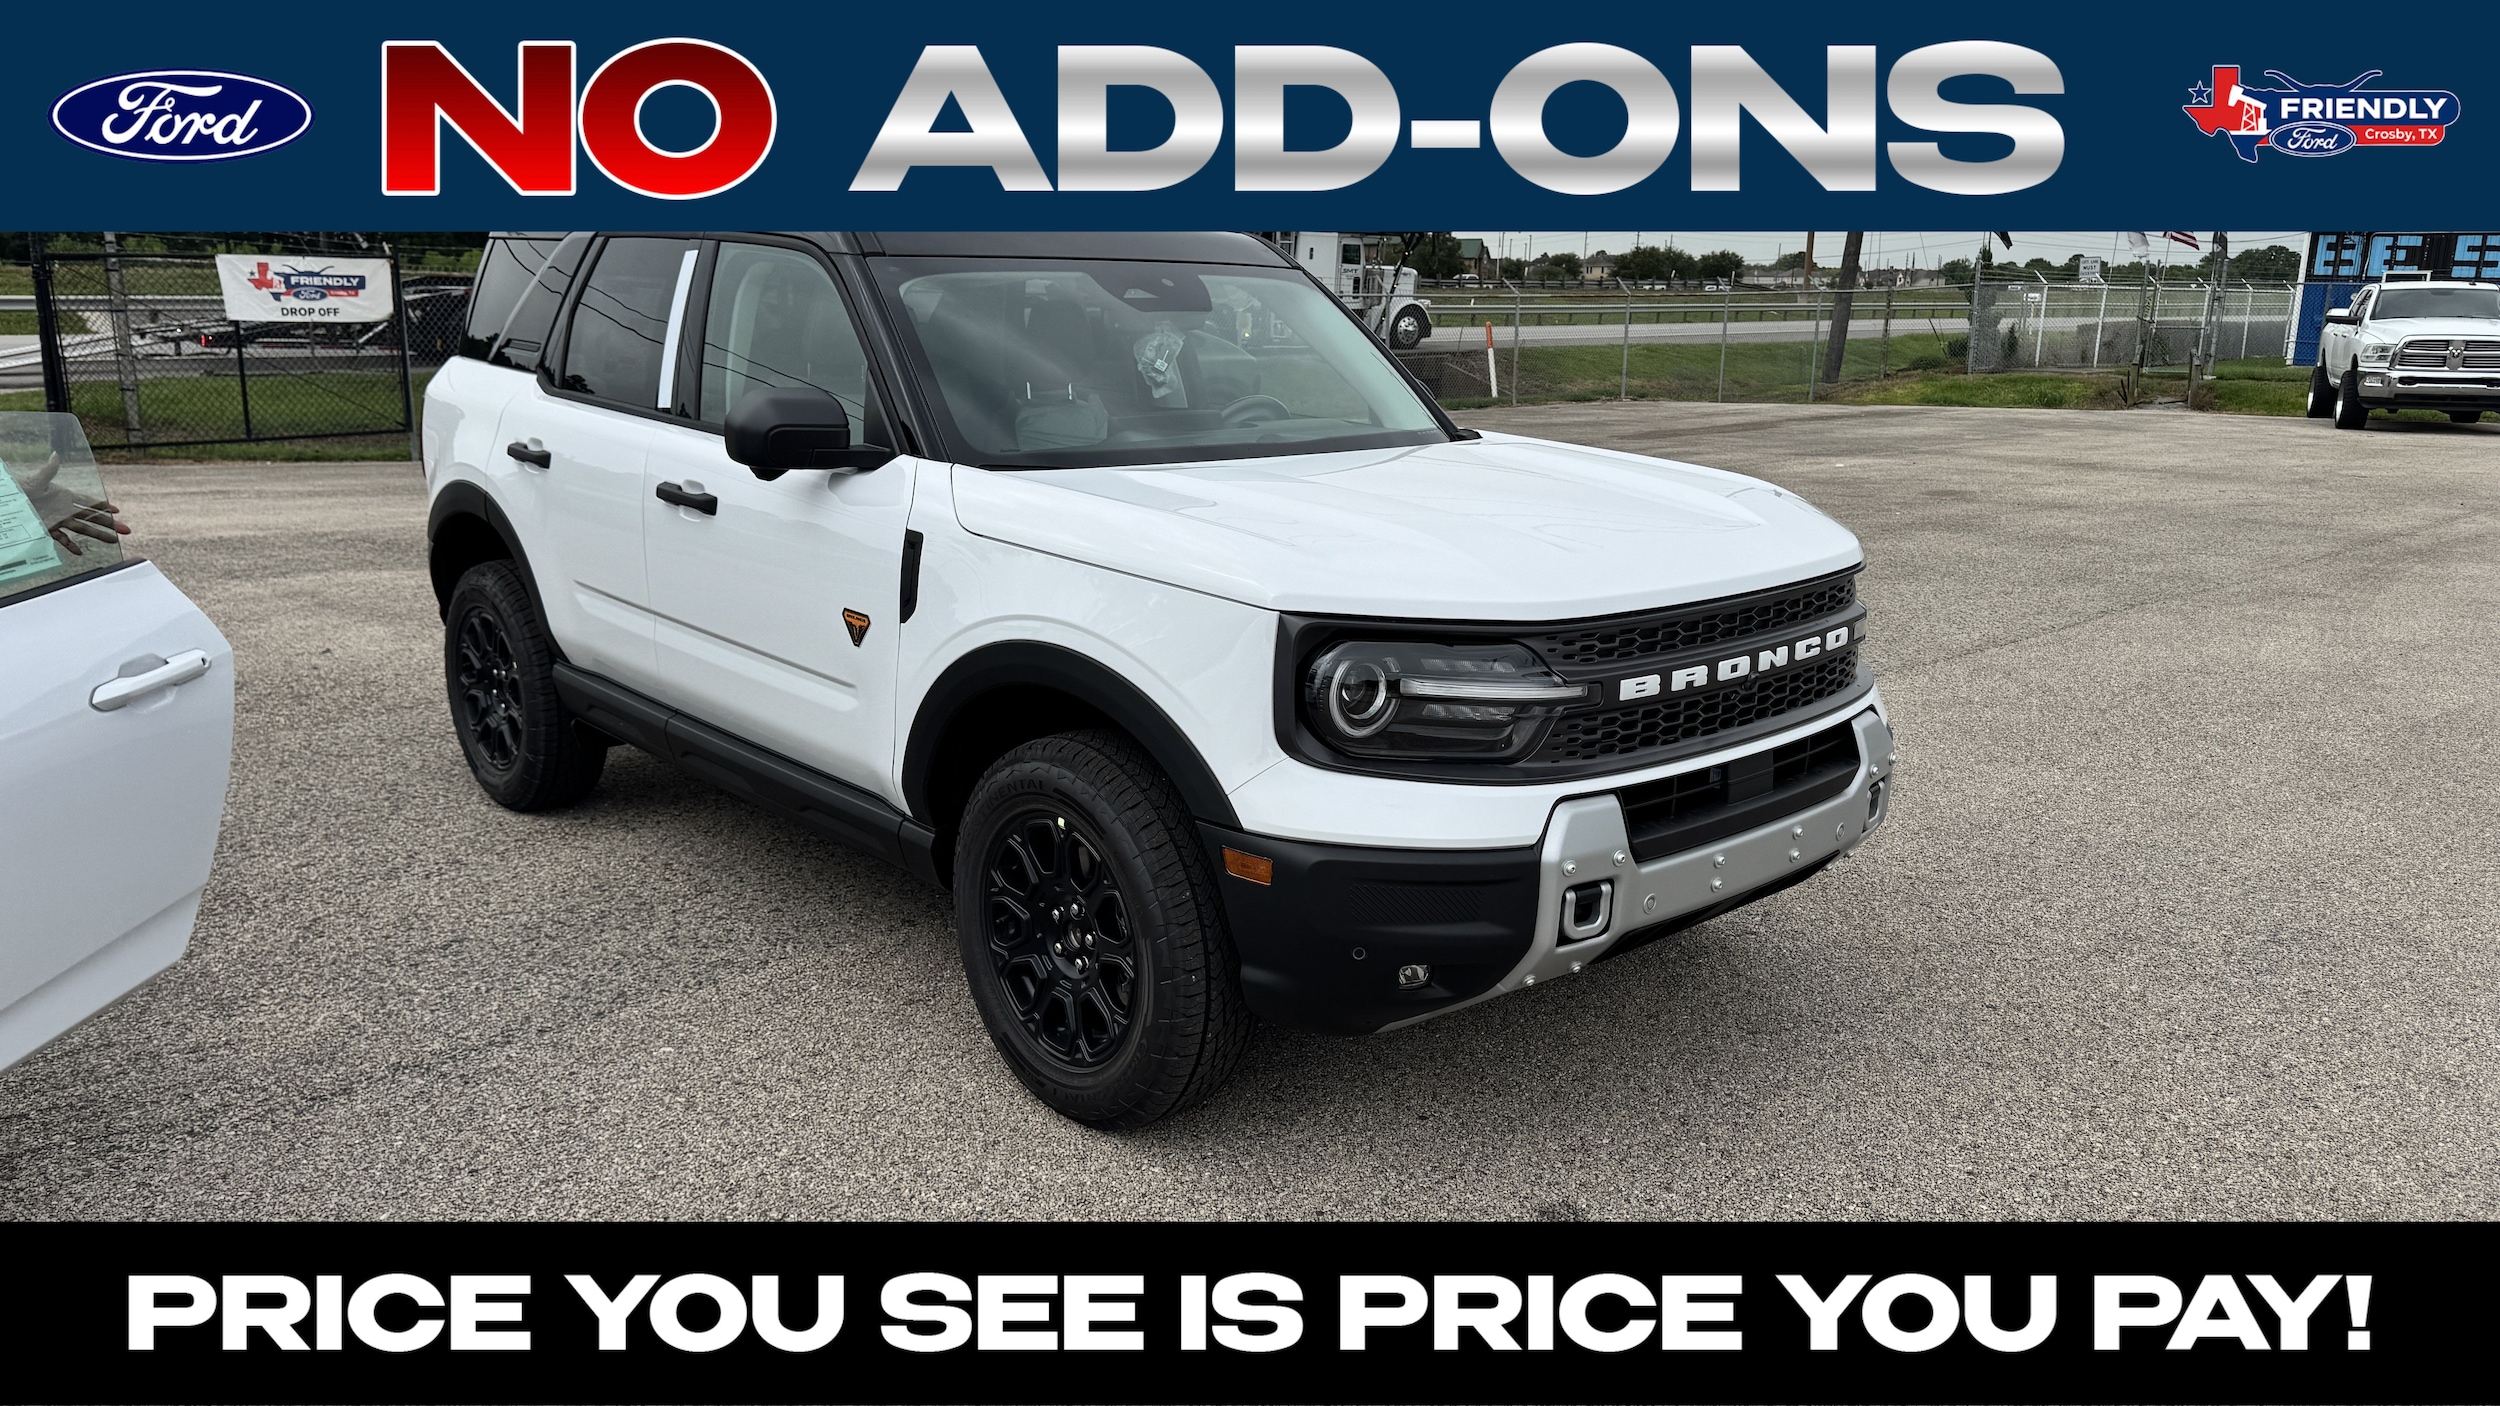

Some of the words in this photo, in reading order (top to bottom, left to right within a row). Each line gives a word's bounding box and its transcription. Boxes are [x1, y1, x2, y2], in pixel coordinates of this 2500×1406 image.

[290, 276, 360, 287] FRIENDLY
[299, 290, 321, 299] Ford
[281, 307, 315, 316] DROP
[318, 308, 340, 316] OFF
[1618, 626, 1849, 701] BRONCO
